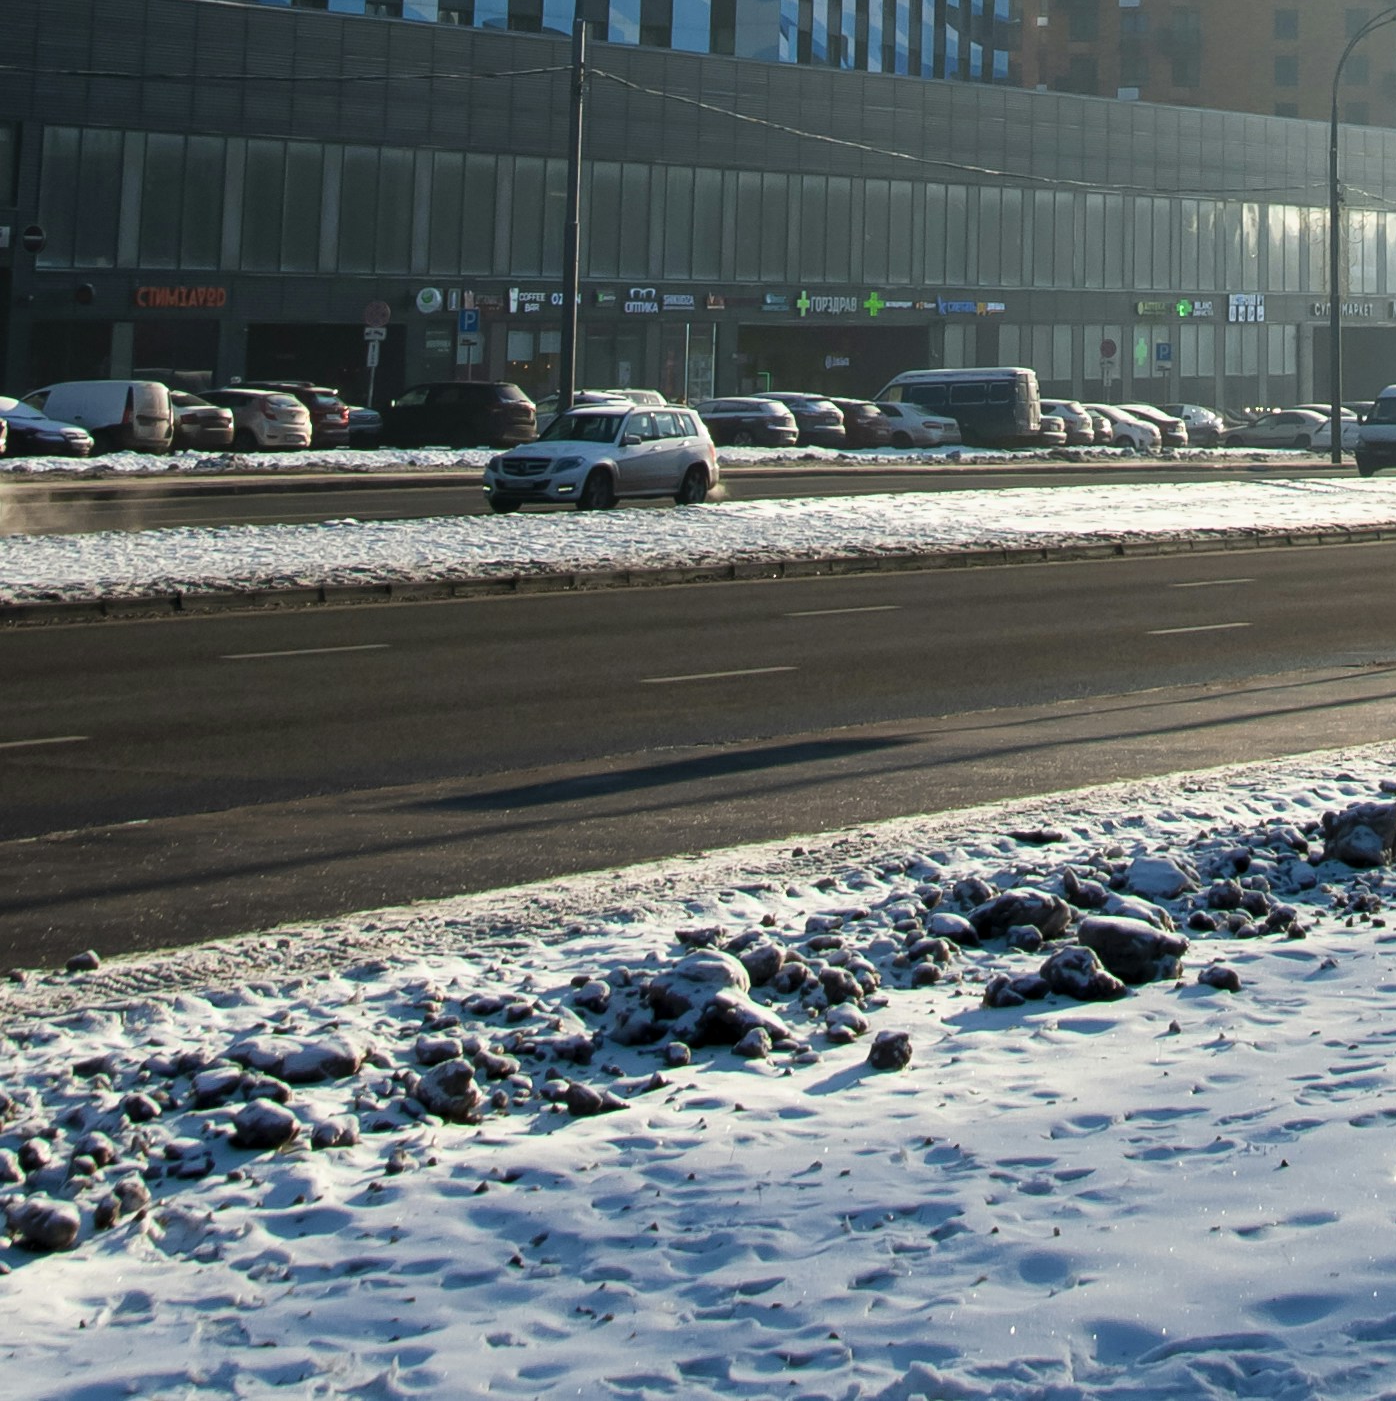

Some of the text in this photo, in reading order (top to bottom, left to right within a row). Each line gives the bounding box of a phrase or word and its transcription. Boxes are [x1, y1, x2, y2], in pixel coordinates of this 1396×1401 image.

[518, 292, 546, 302] COFFEE
[551, 292, 582, 305] OZN
[524, 303, 541, 312] BAR
[624, 301, 659, 313] ОПТИКА
[810, 296, 858, 314] ГОРЗДРАВ
[1314, 303, 1374, 317] СУПМАРКЕТ
